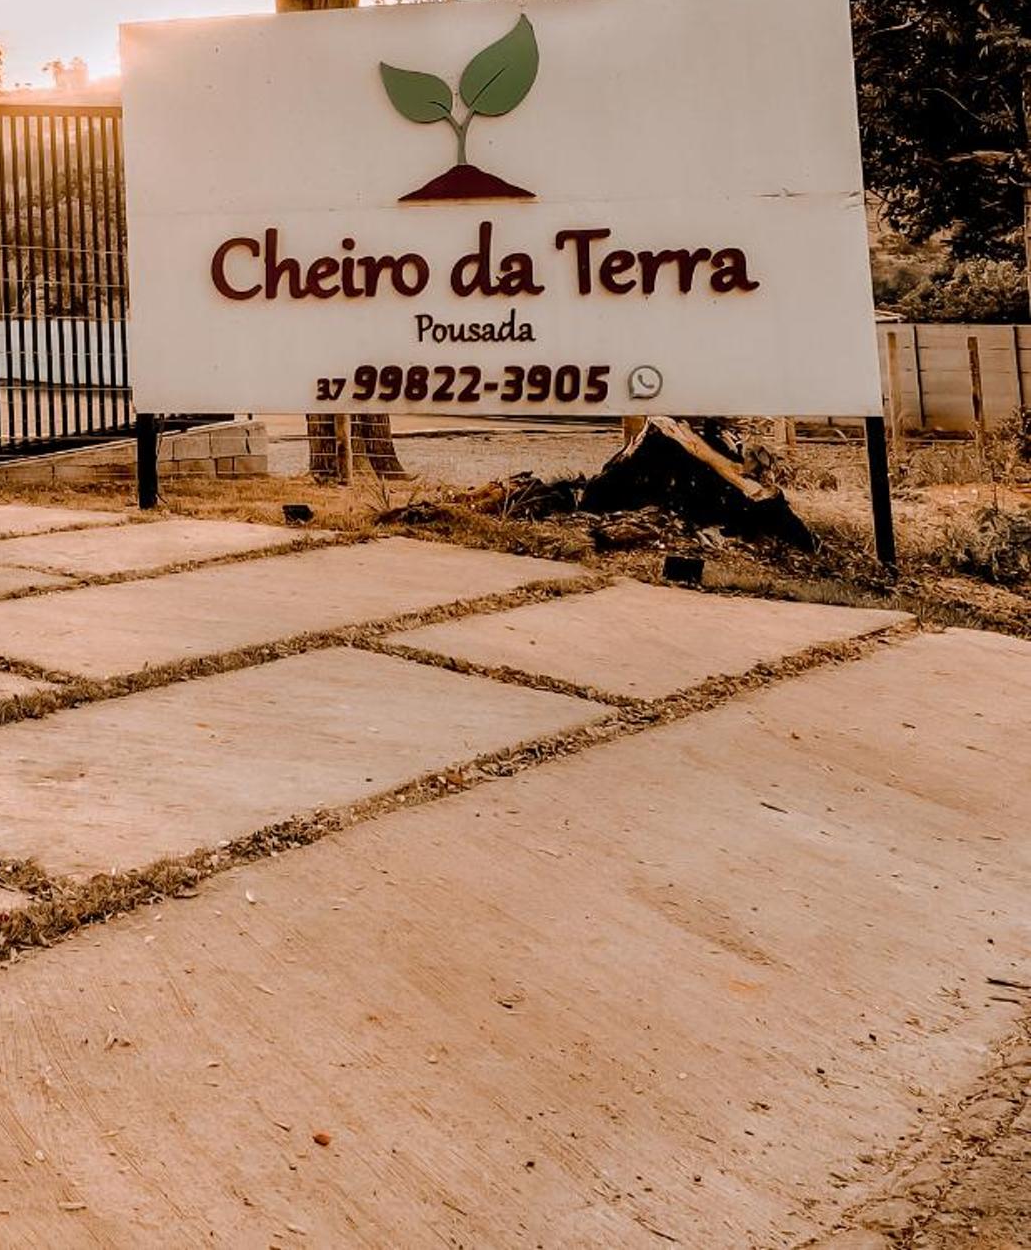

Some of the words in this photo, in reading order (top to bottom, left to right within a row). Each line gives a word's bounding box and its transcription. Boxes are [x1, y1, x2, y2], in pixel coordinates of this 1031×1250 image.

[210, 227, 430, 302] Cheiro
[449, 220, 546, 299] da
[553, 227, 761, 297] Terra
[414, 307, 537, 345] Pousada
[315, 376, 348, 403] 37
[351, 364, 612, 405] 99822-3905
